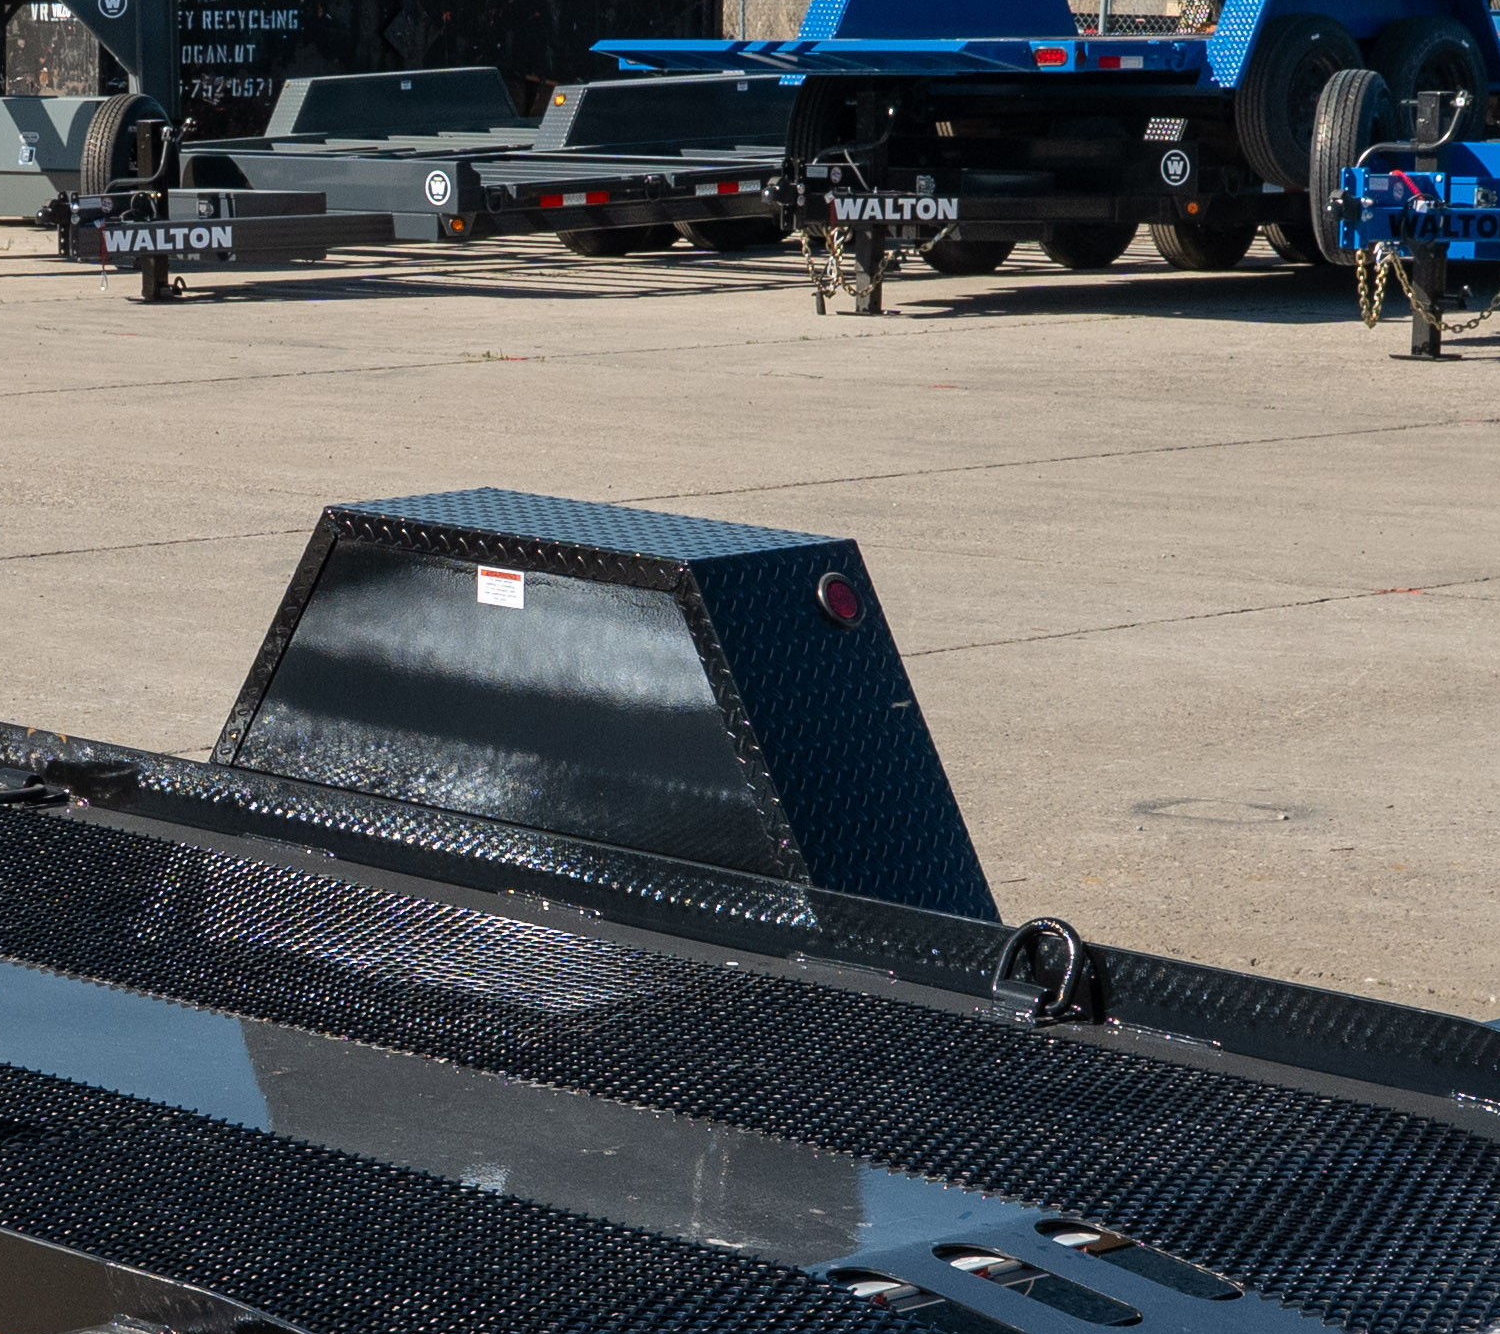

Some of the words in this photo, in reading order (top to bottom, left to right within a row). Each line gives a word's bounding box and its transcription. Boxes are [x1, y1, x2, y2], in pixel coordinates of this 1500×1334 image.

[202, 9, 299, 30] RECYCLING
[834, 197, 958, 220] WALTON
[103, 225, 233, 253] WALTON
